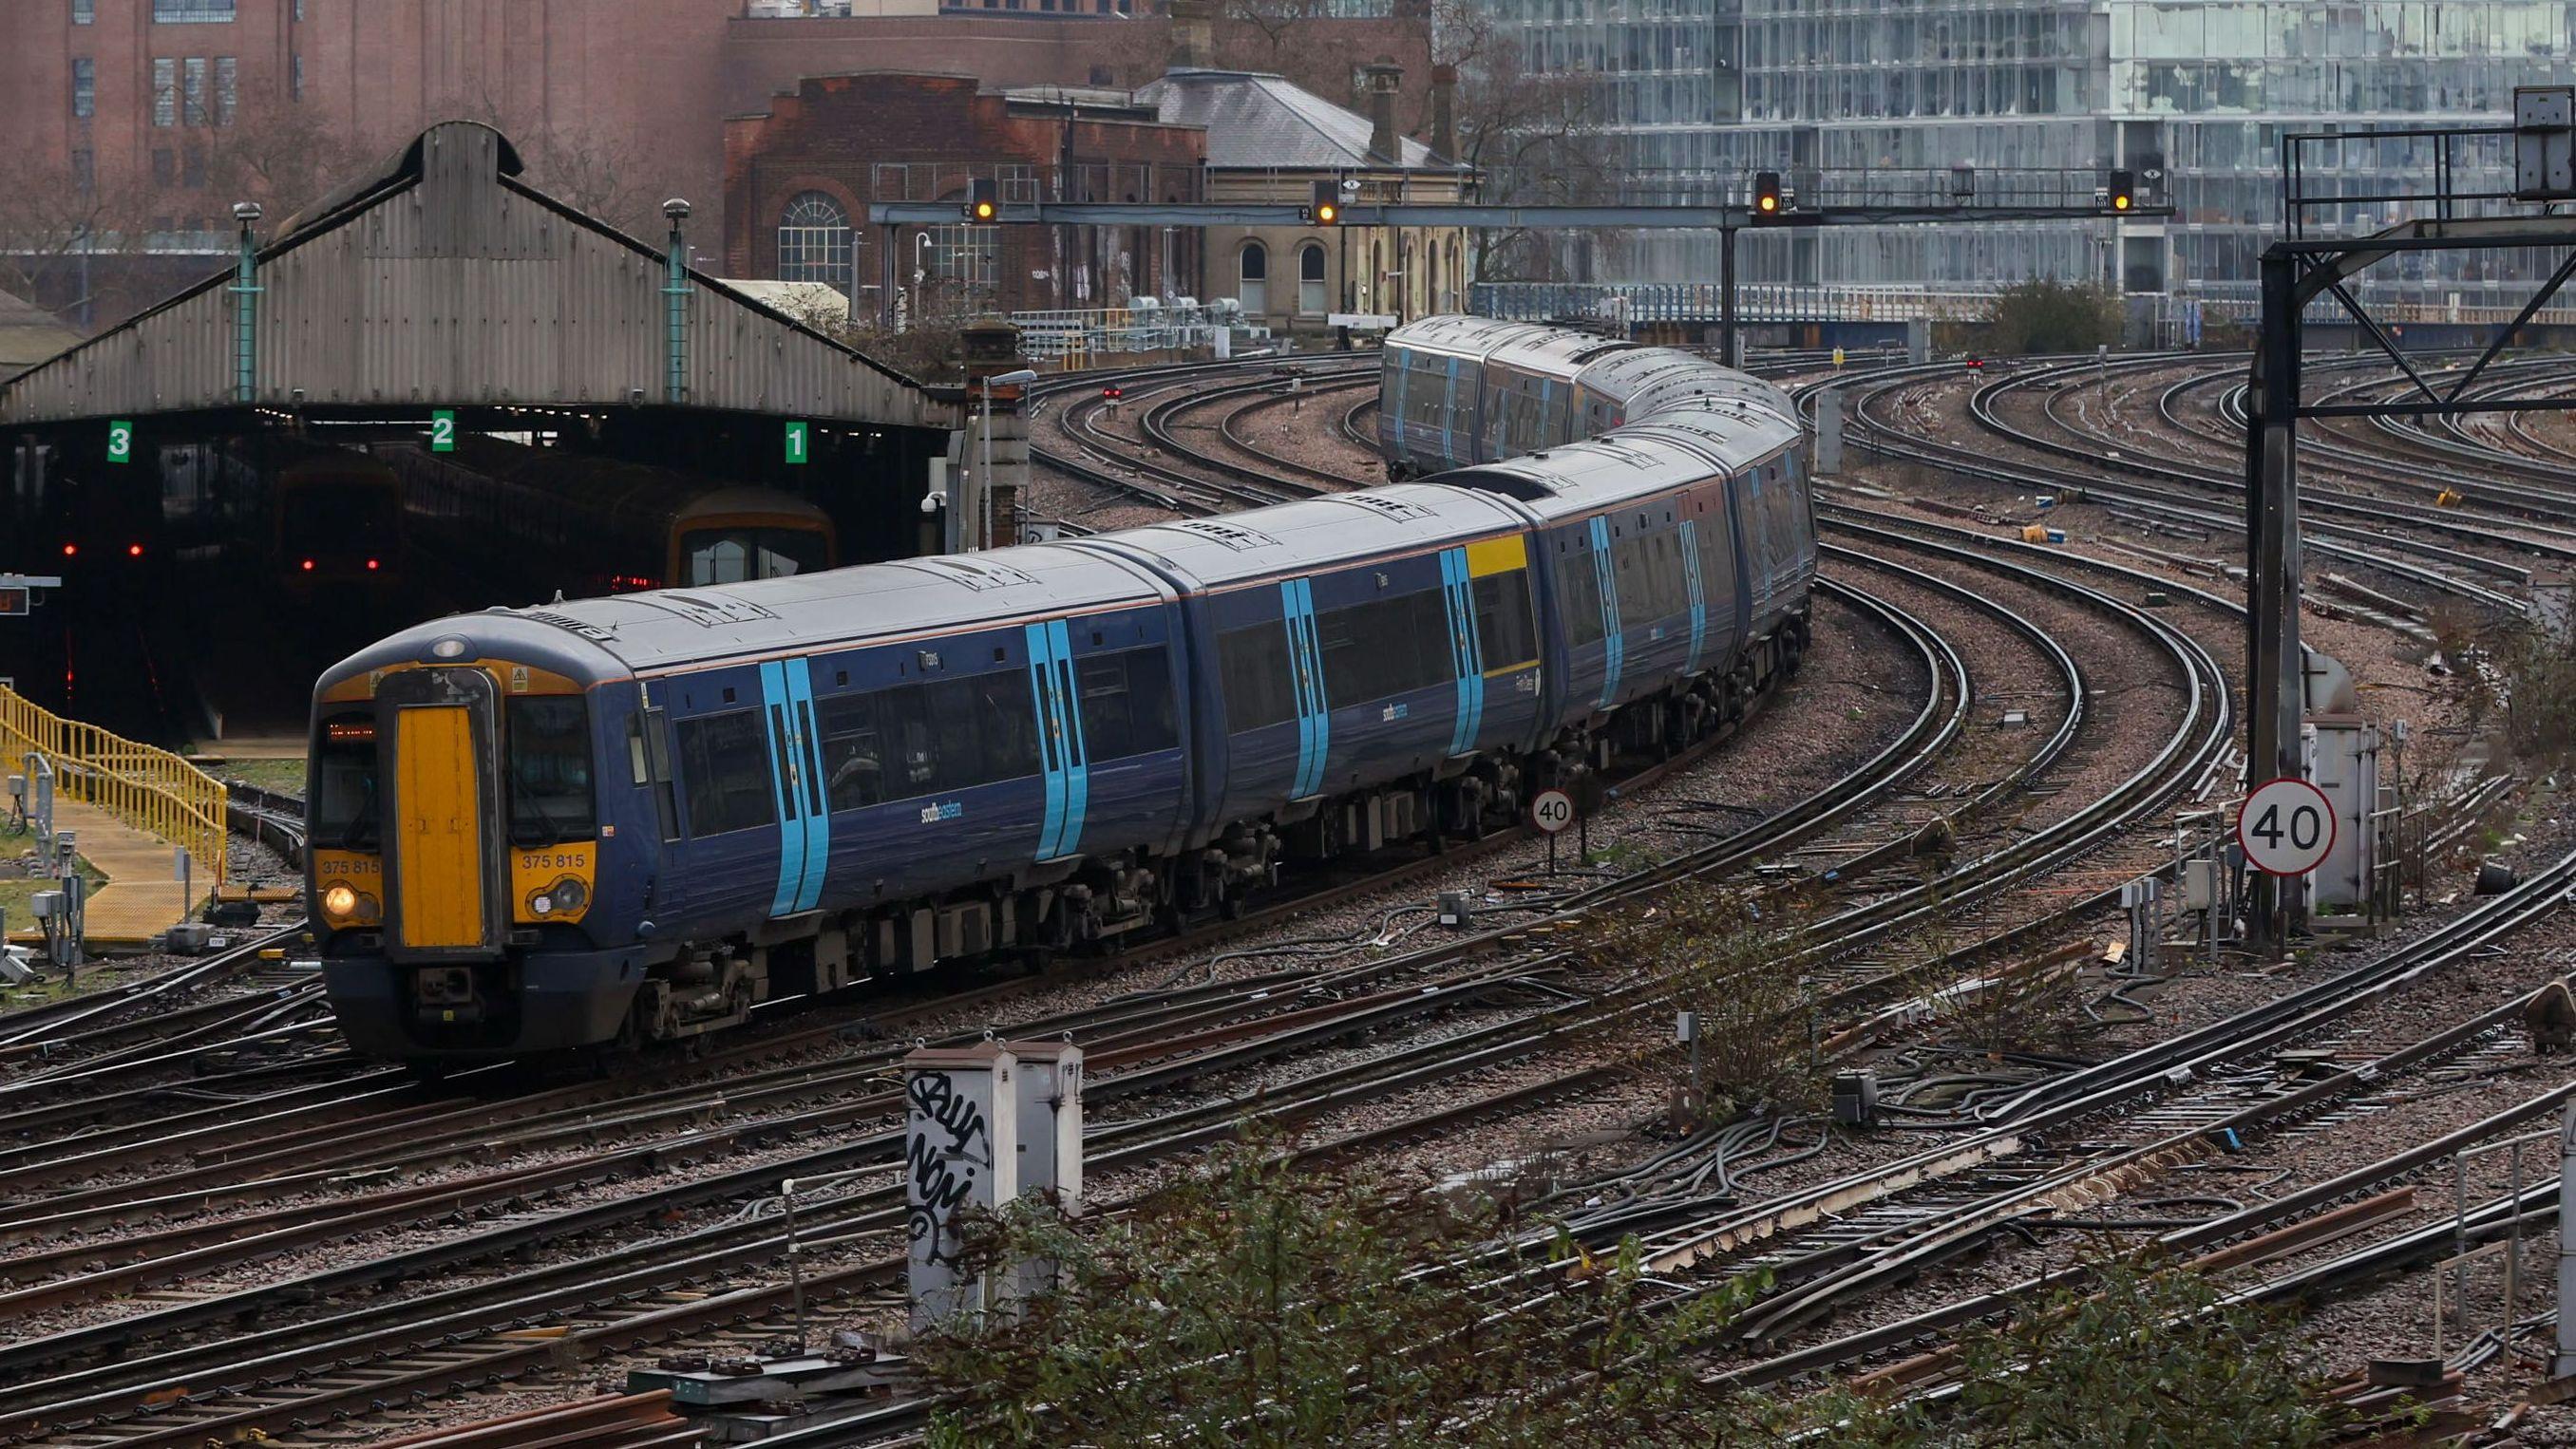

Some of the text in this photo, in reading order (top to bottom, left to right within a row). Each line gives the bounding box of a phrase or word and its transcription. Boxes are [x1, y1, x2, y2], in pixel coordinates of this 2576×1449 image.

[109, 428, 129, 455] 3
[434, 418, 453, 443] 2
[788, 429, 801, 456] 1
[1539, 800, 1567, 821] 40
[2251, 803, 2320, 850] 40
[323, 860, 380, 874] 375 815
[522, 854, 584, 870] 375 815
